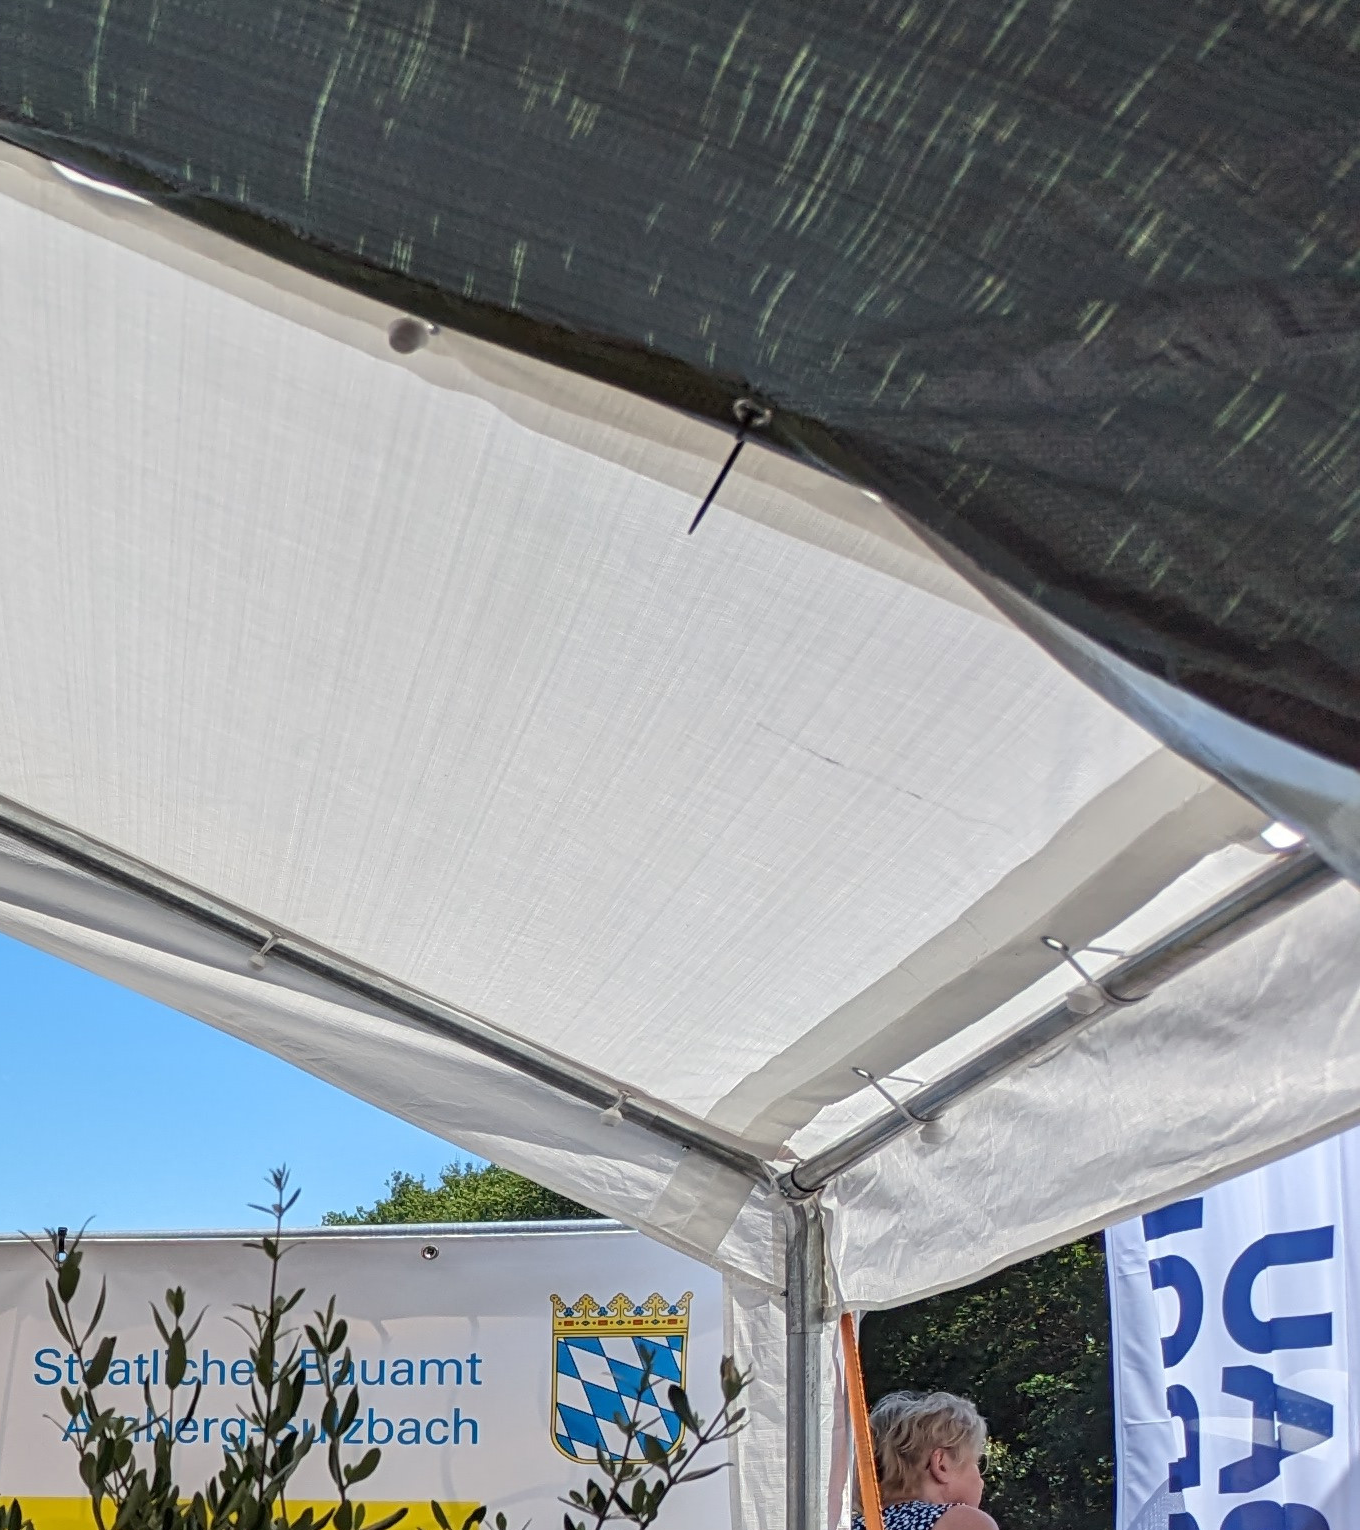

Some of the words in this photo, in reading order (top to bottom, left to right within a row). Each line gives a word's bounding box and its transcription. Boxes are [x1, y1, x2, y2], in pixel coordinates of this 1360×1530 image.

[34, 1348, 280, 1386] Statlche
[300, 1349, 483, 1386] Bauamt
[61, 1406, 479, 1453] Aberg-uzbach
